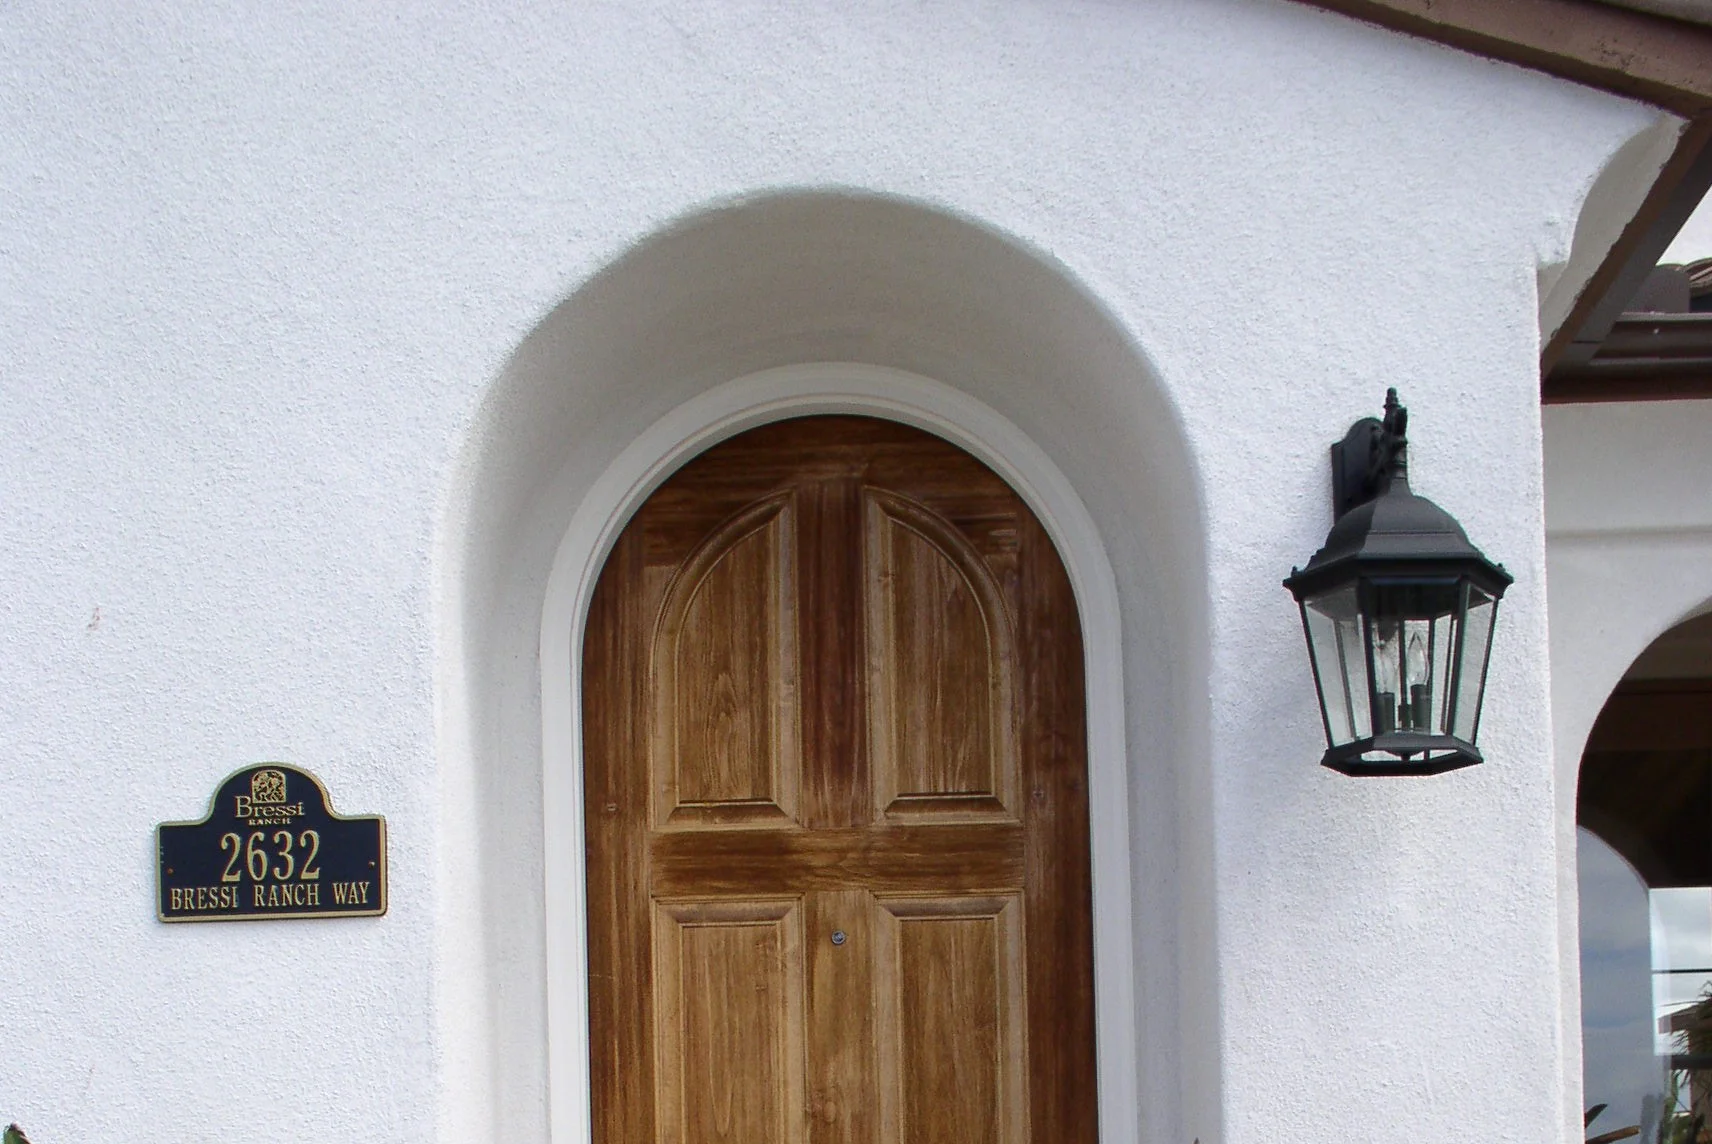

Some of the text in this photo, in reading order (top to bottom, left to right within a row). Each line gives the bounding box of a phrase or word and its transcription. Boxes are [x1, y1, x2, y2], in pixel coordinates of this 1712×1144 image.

[234, 795, 305, 818] Bressi
[248, 817, 292, 826] RANCH
[220, 829, 320, 882] 2632
[171, 881, 371, 910] BRESSI RANCH WAY
